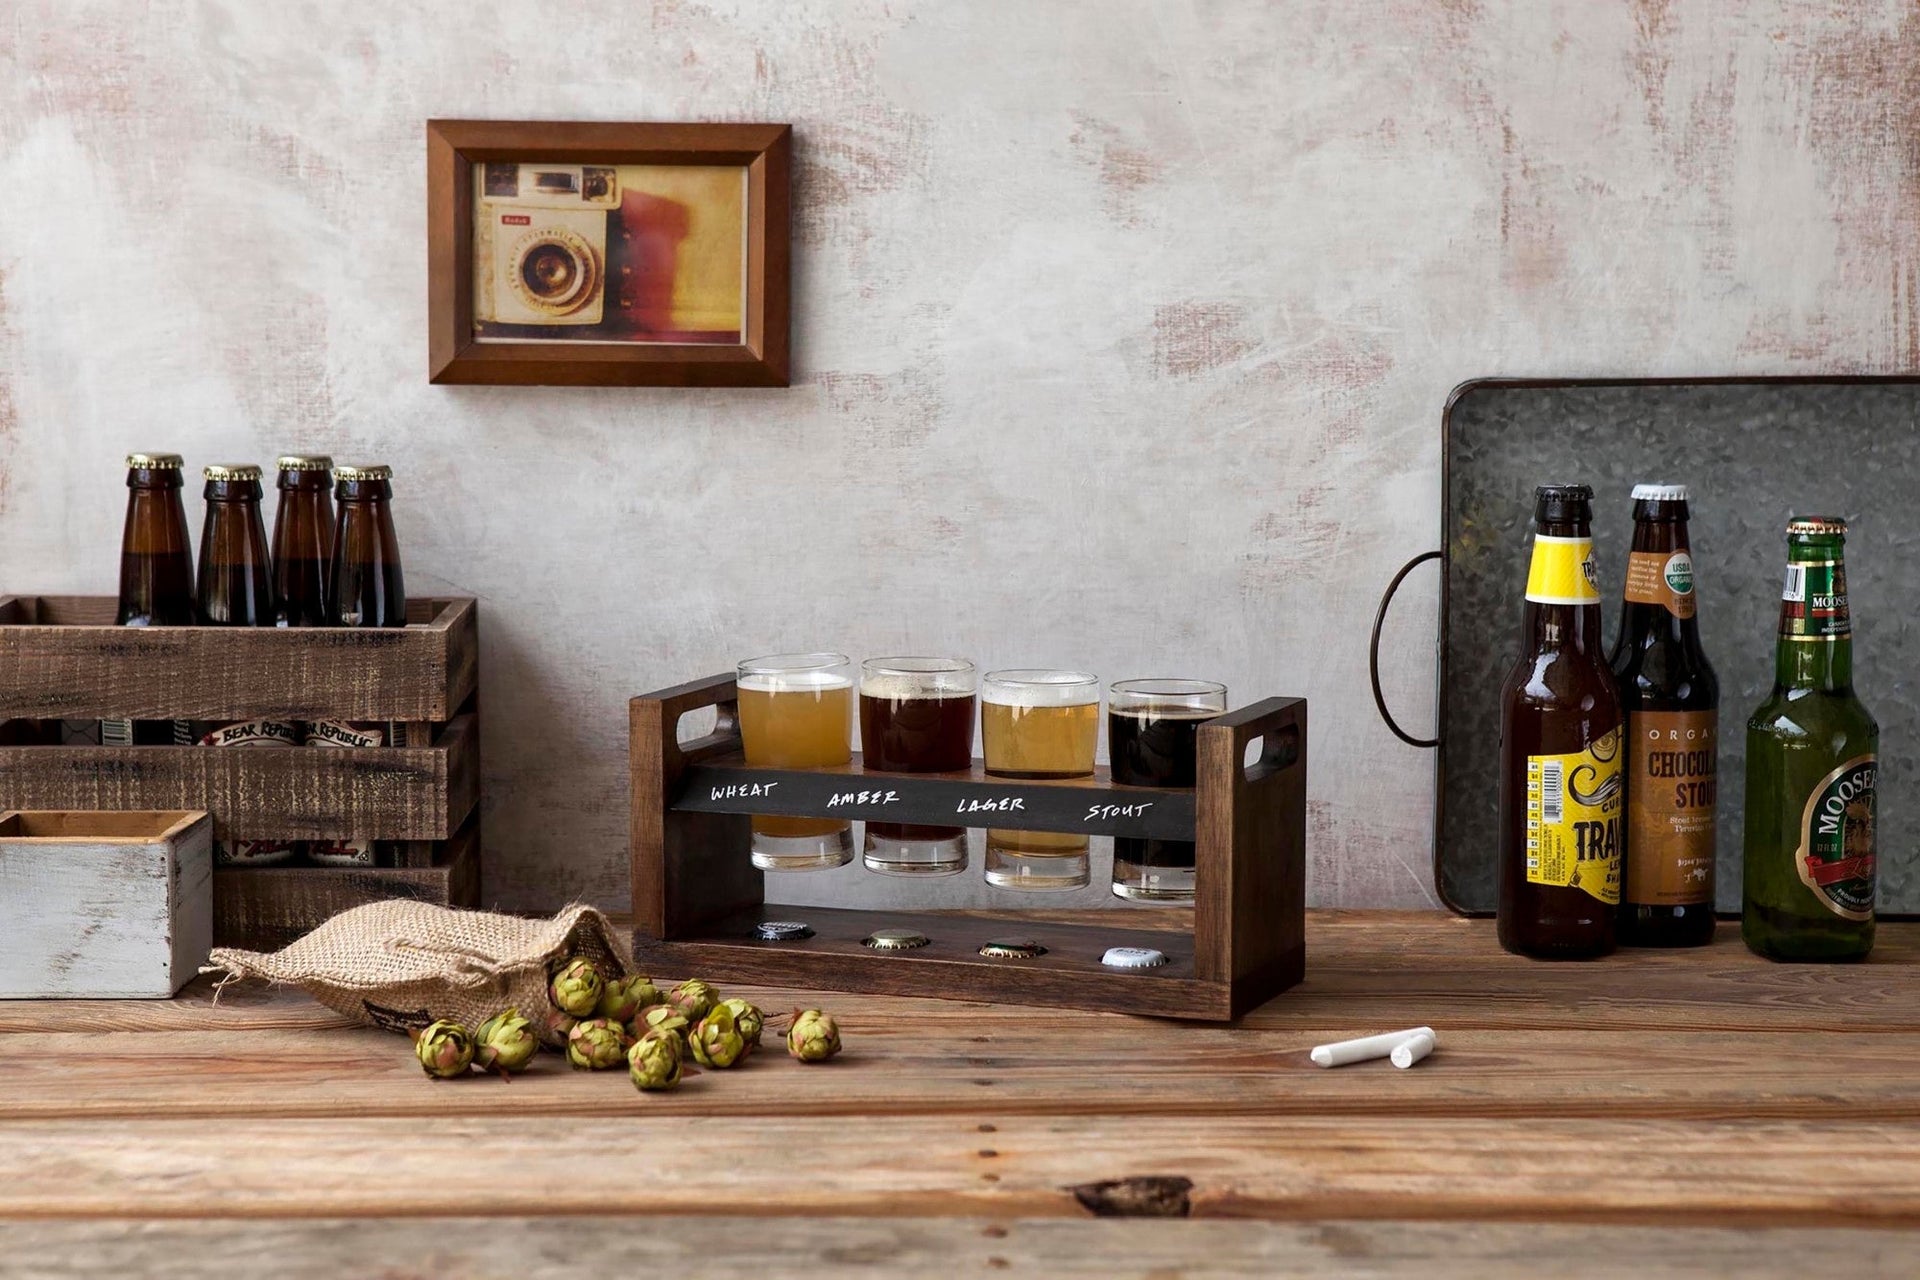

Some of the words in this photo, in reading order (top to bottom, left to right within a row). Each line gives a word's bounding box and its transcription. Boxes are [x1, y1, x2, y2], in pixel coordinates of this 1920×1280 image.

[1672, 562, 1690, 573] USDA
[222, 723, 257, 743] BEAR
[319, 722, 373, 748] REPUBLIC
[711, 782, 778, 800] WHEAT
[827, 790, 900, 808] AMBER
[957, 797, 1025, 813] LAGER
[1084, 802, 1153, 821] STOUT
